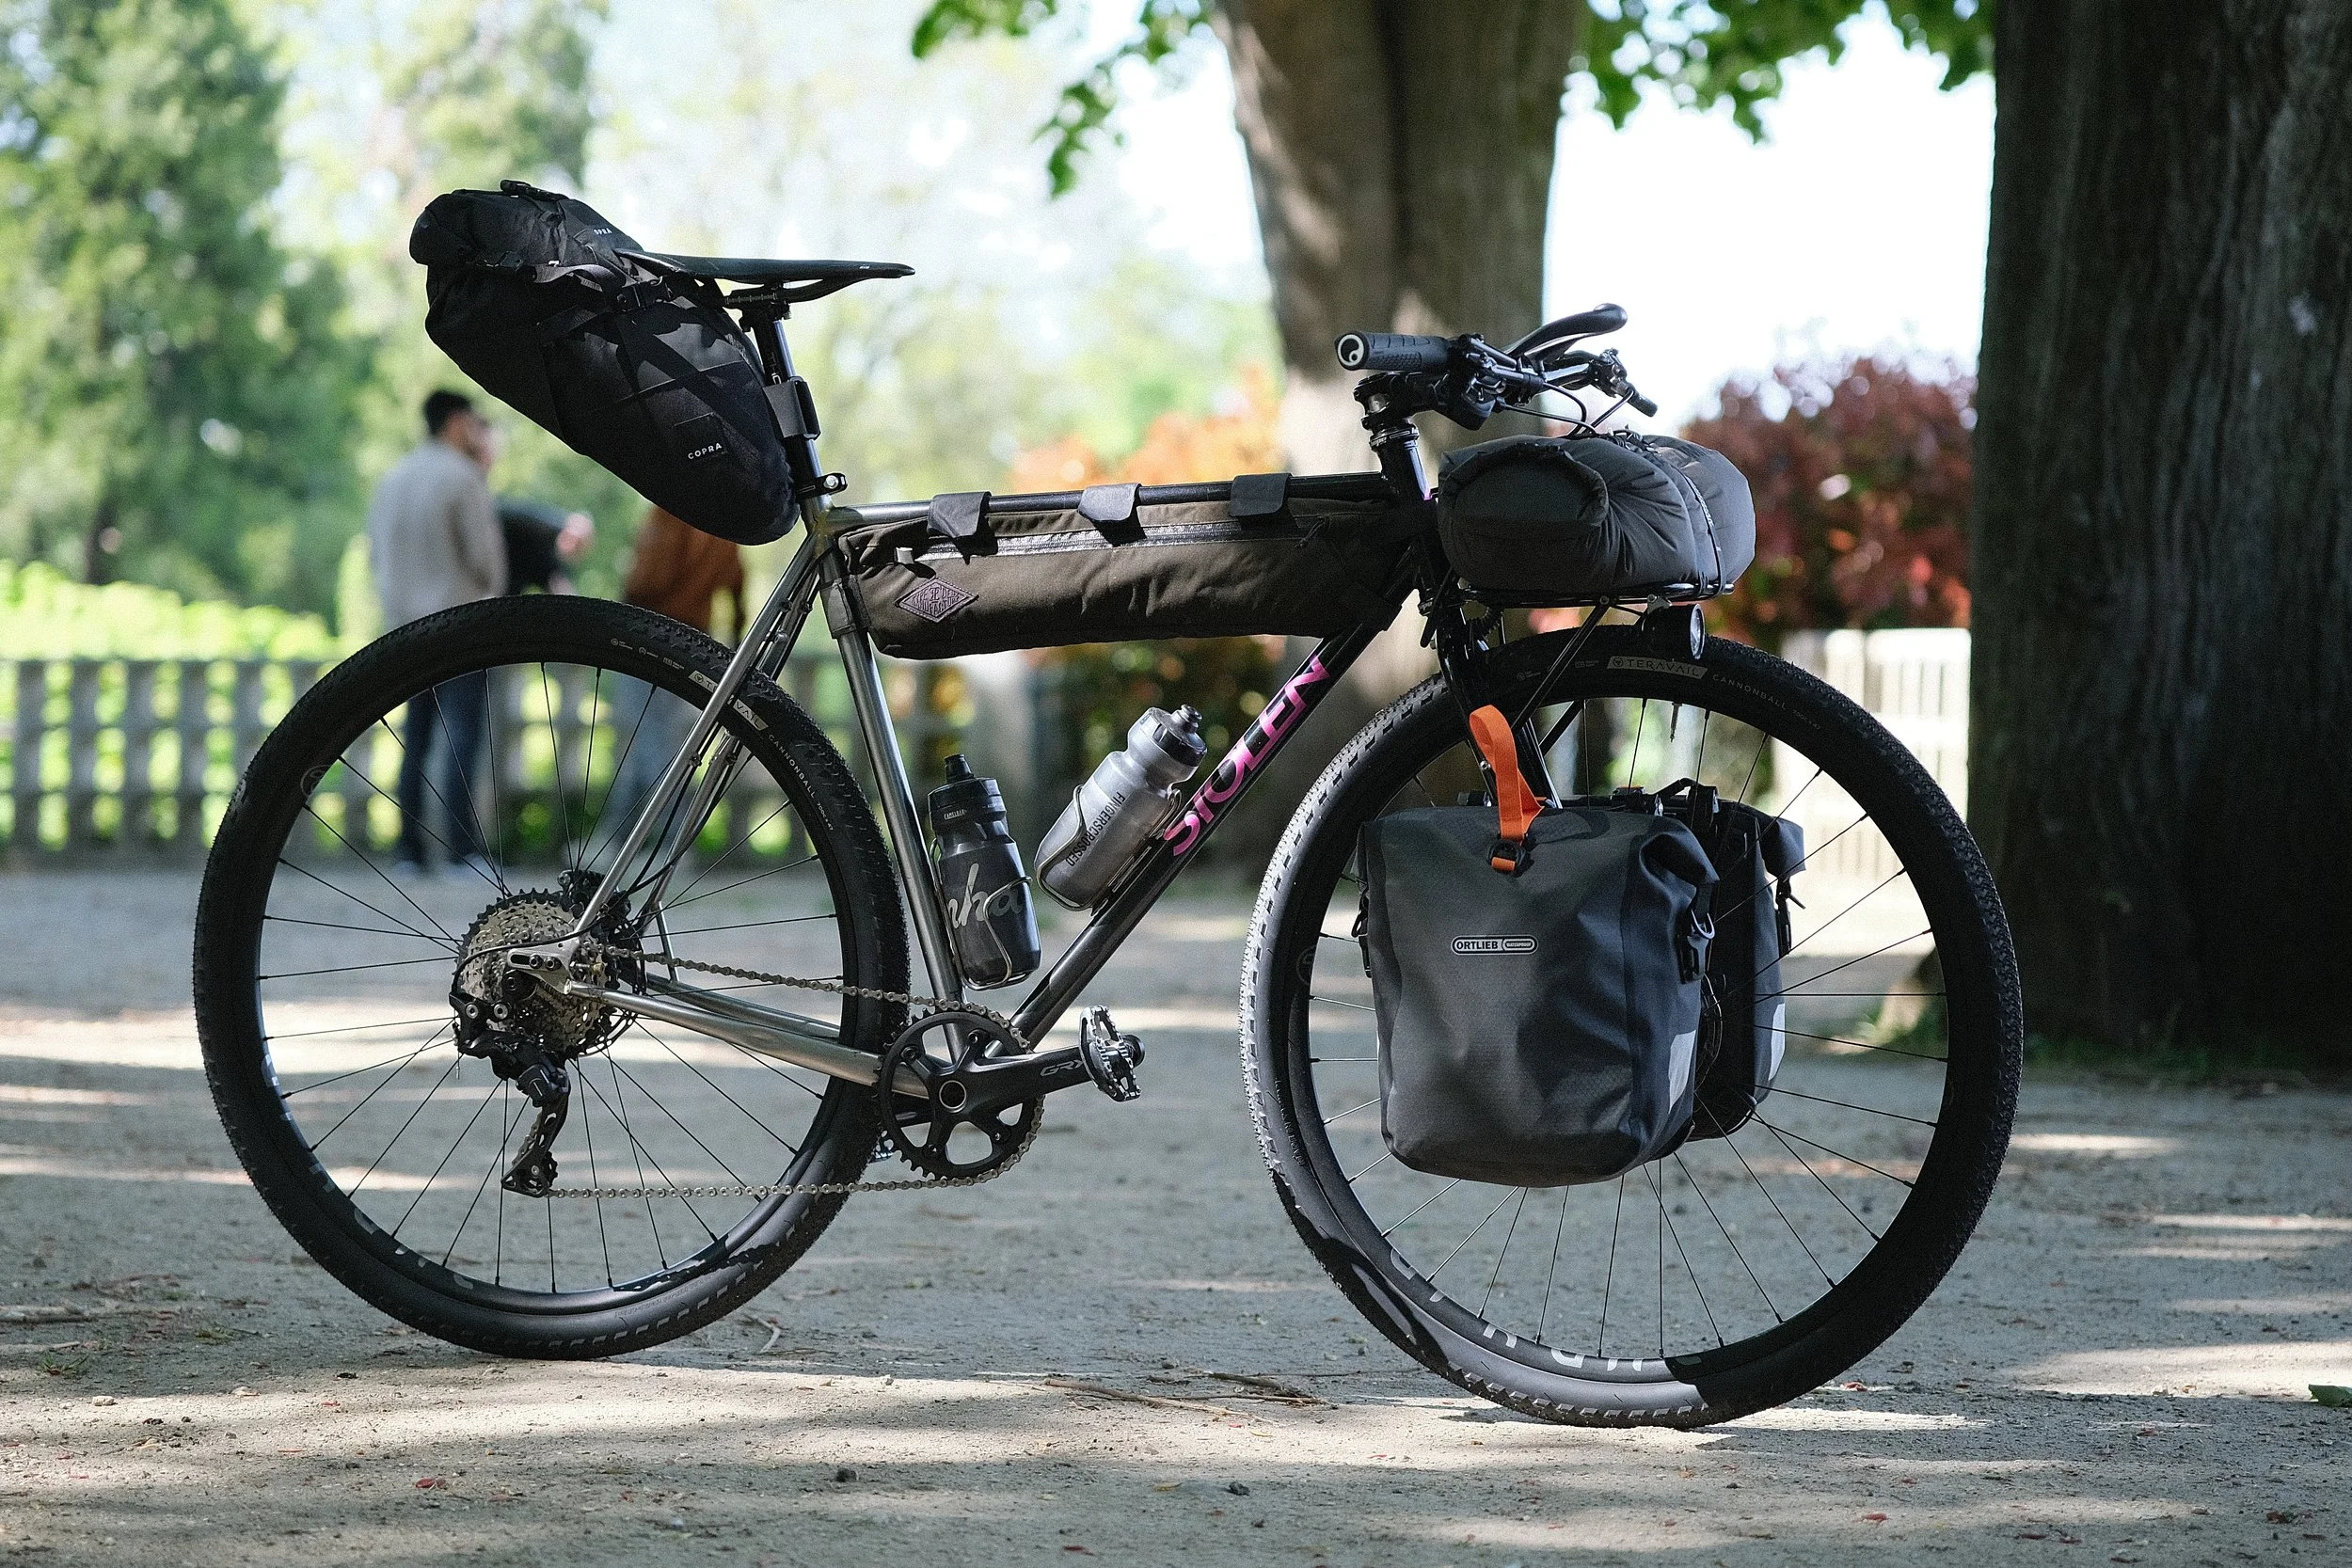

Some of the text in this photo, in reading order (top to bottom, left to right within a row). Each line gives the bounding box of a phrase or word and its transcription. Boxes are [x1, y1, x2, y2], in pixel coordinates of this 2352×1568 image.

[688, 443, 722, 459] COPRA
[1627, 658, 1702, 677] TERAVAIL
[707, 680, 761, 728] TVAIL
[1712, 673, 1787, 711] CANNONBALL
[769, 735, 815, 798] CANNONBALL
[1164, 654, 1330, 856] STOLEN
[1065, 791, 1126, 866] FINGERSCROSSED
[1456, 941, 1499, 950] ORTLIEB
